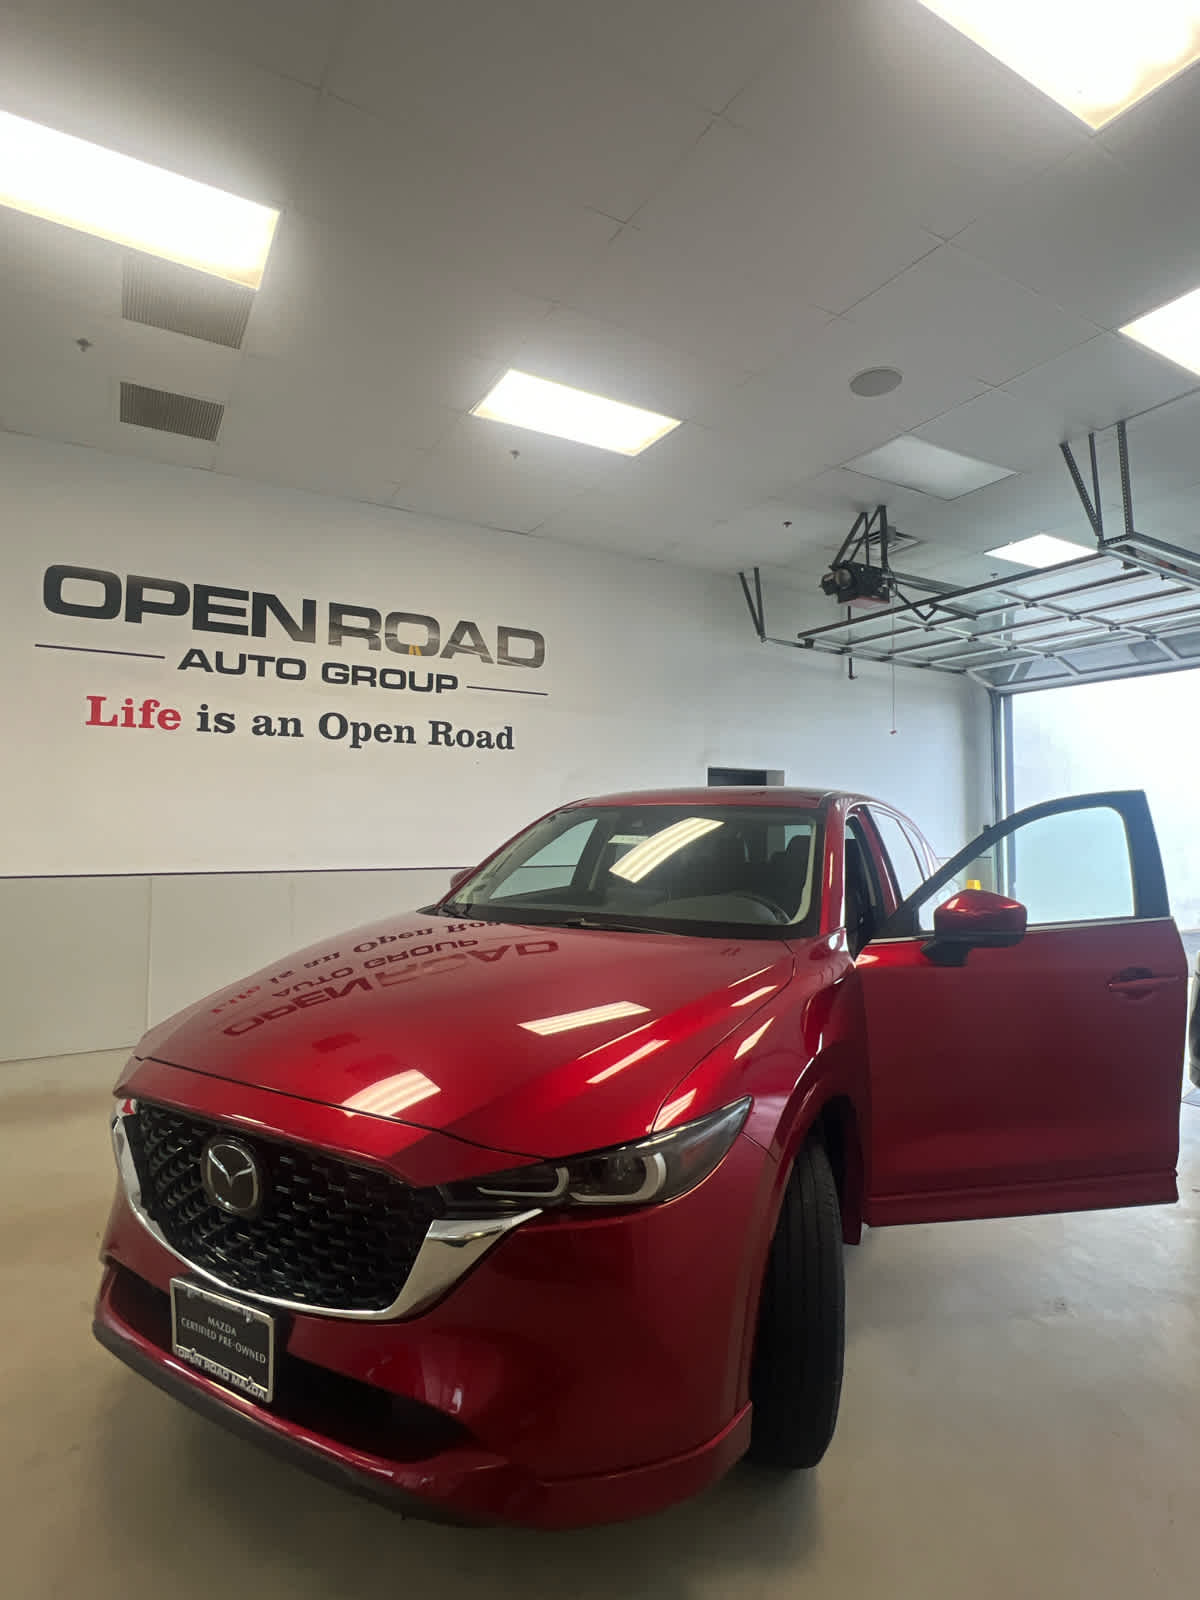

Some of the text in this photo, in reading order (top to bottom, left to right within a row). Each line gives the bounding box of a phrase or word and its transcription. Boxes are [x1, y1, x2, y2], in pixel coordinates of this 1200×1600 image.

[178, 649, 458, 694] AUTO GROUP
[86, 695, 515, 750] Life is an Open Road
[182, 1317, 266, 1364] CERTIFIED PRE-OWNED
[207, 1316, 237, 1337] MAZDA
